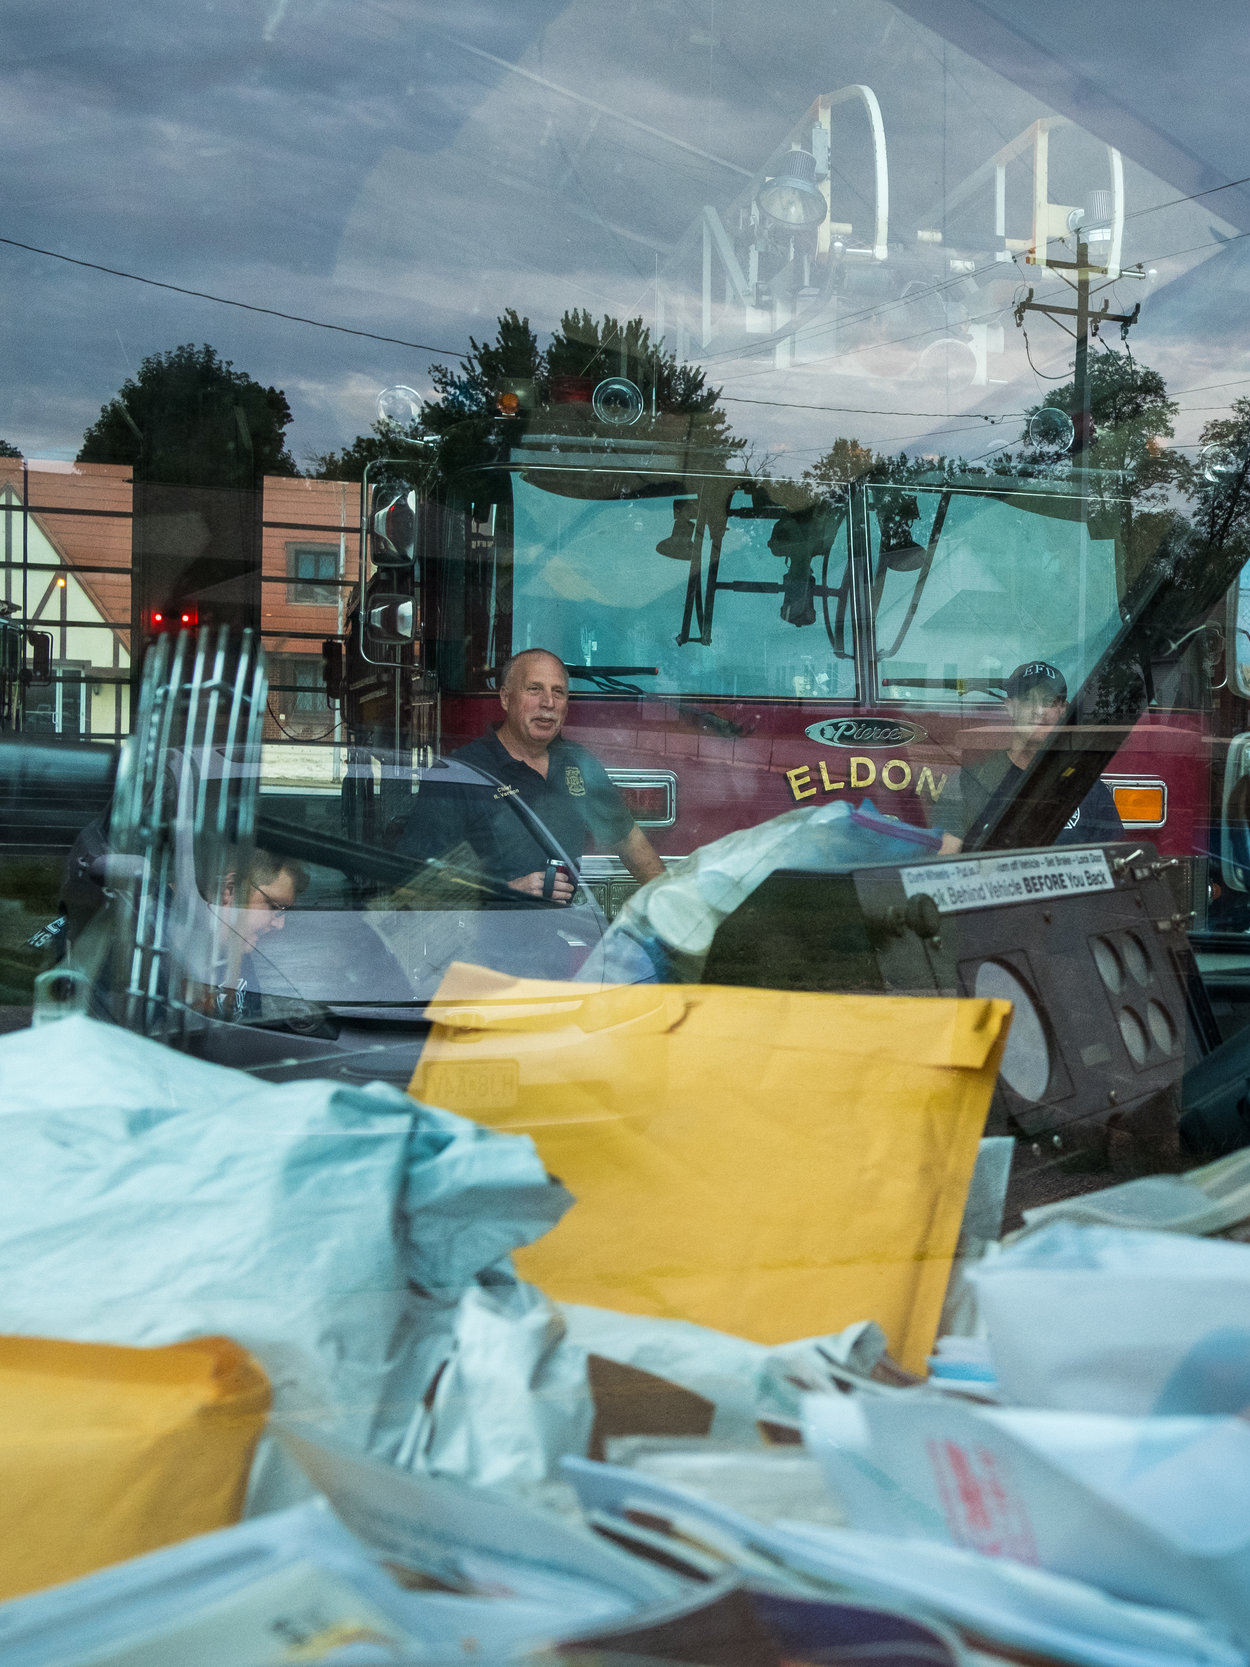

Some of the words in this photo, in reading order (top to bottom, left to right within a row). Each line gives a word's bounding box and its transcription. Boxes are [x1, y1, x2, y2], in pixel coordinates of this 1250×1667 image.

[1022, 664, 1056, 680] EFD
[832, 720, 902, 744] Pierce
[786, 755, 948, 803] ELDON
[947, 882, 986, 905] Behind
[985, 878, 1023, 900] Vehicle
[1022, 873, 1068, 894] BEFORE
[1066, 872, 1085, 888] You
[1084, 869, 1108, 886] Back
